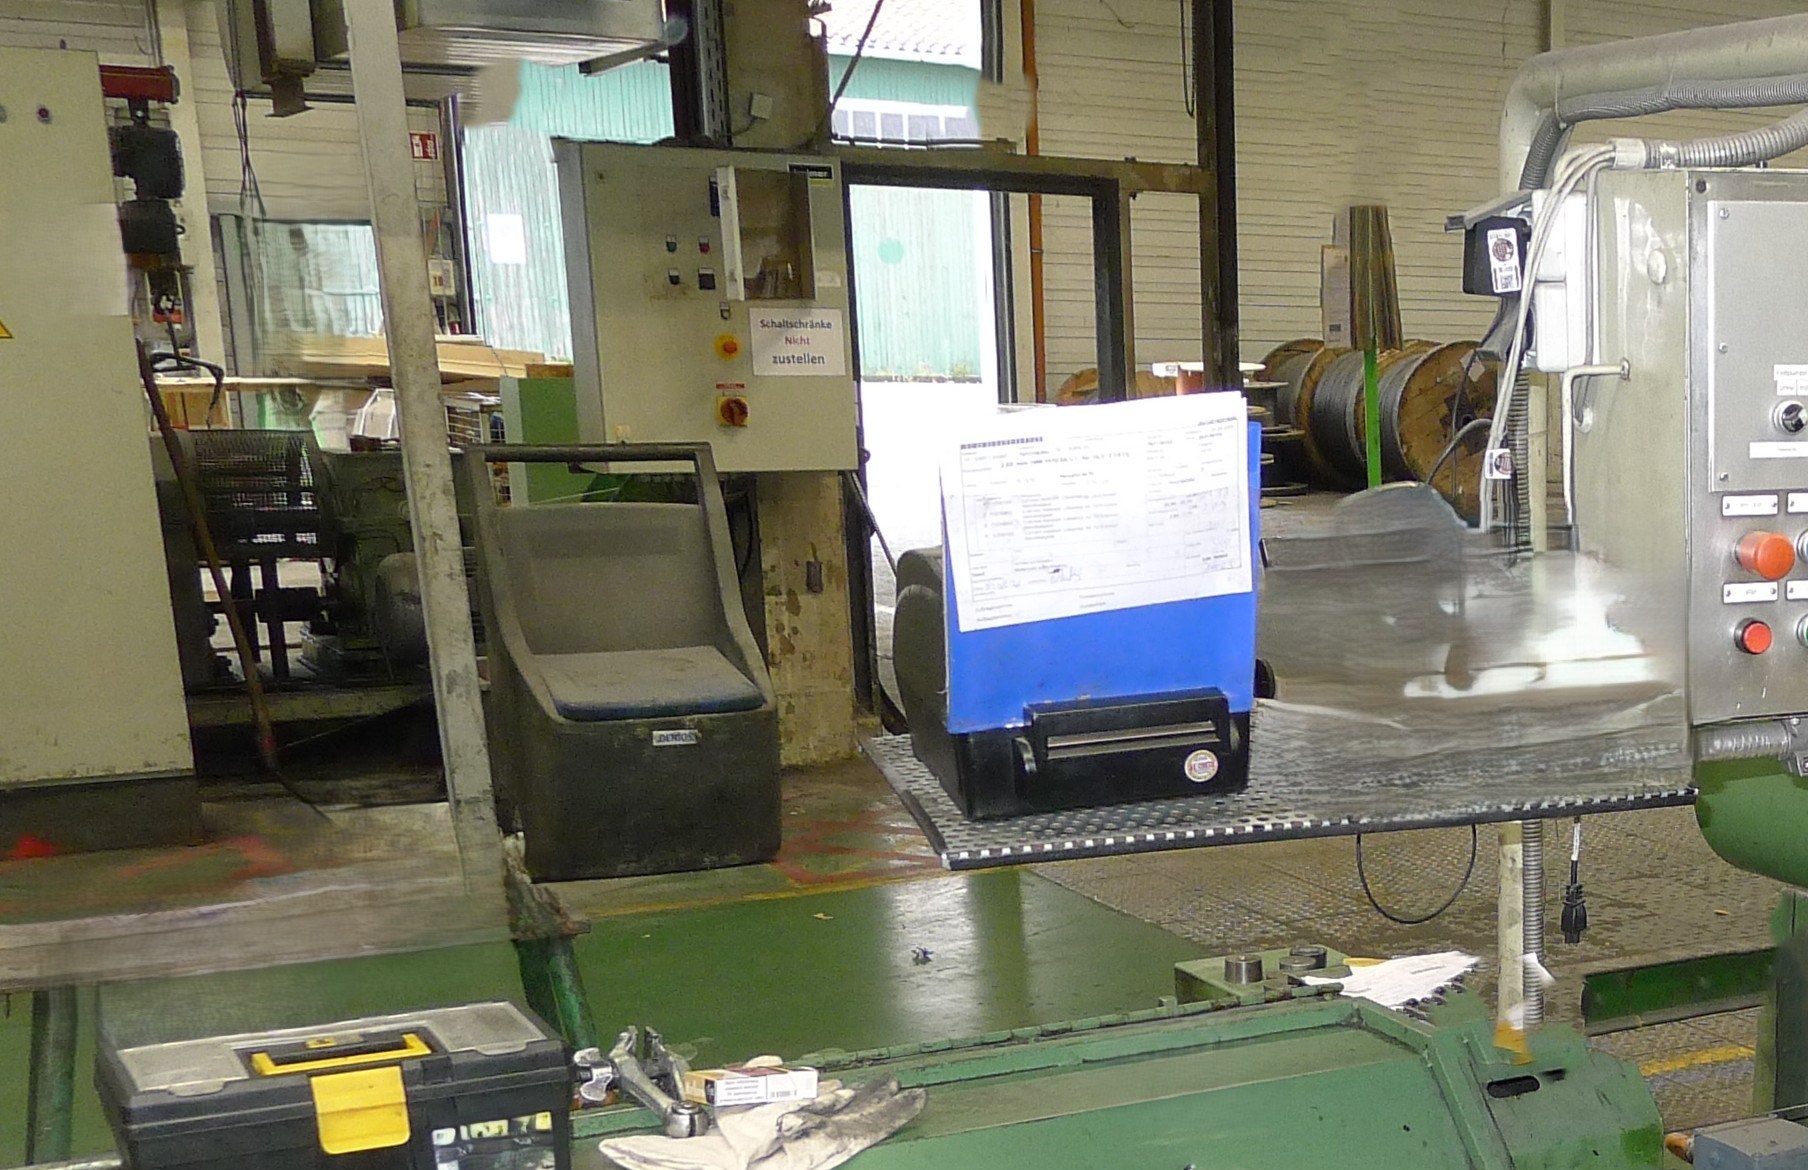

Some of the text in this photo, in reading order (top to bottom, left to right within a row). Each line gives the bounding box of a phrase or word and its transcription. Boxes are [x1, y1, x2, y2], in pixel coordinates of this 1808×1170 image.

[759, 318, 833, 330] Schaltschränke
[784, 335, 811, 346] Nicht
[771, 353, 826, 366] zustellen
